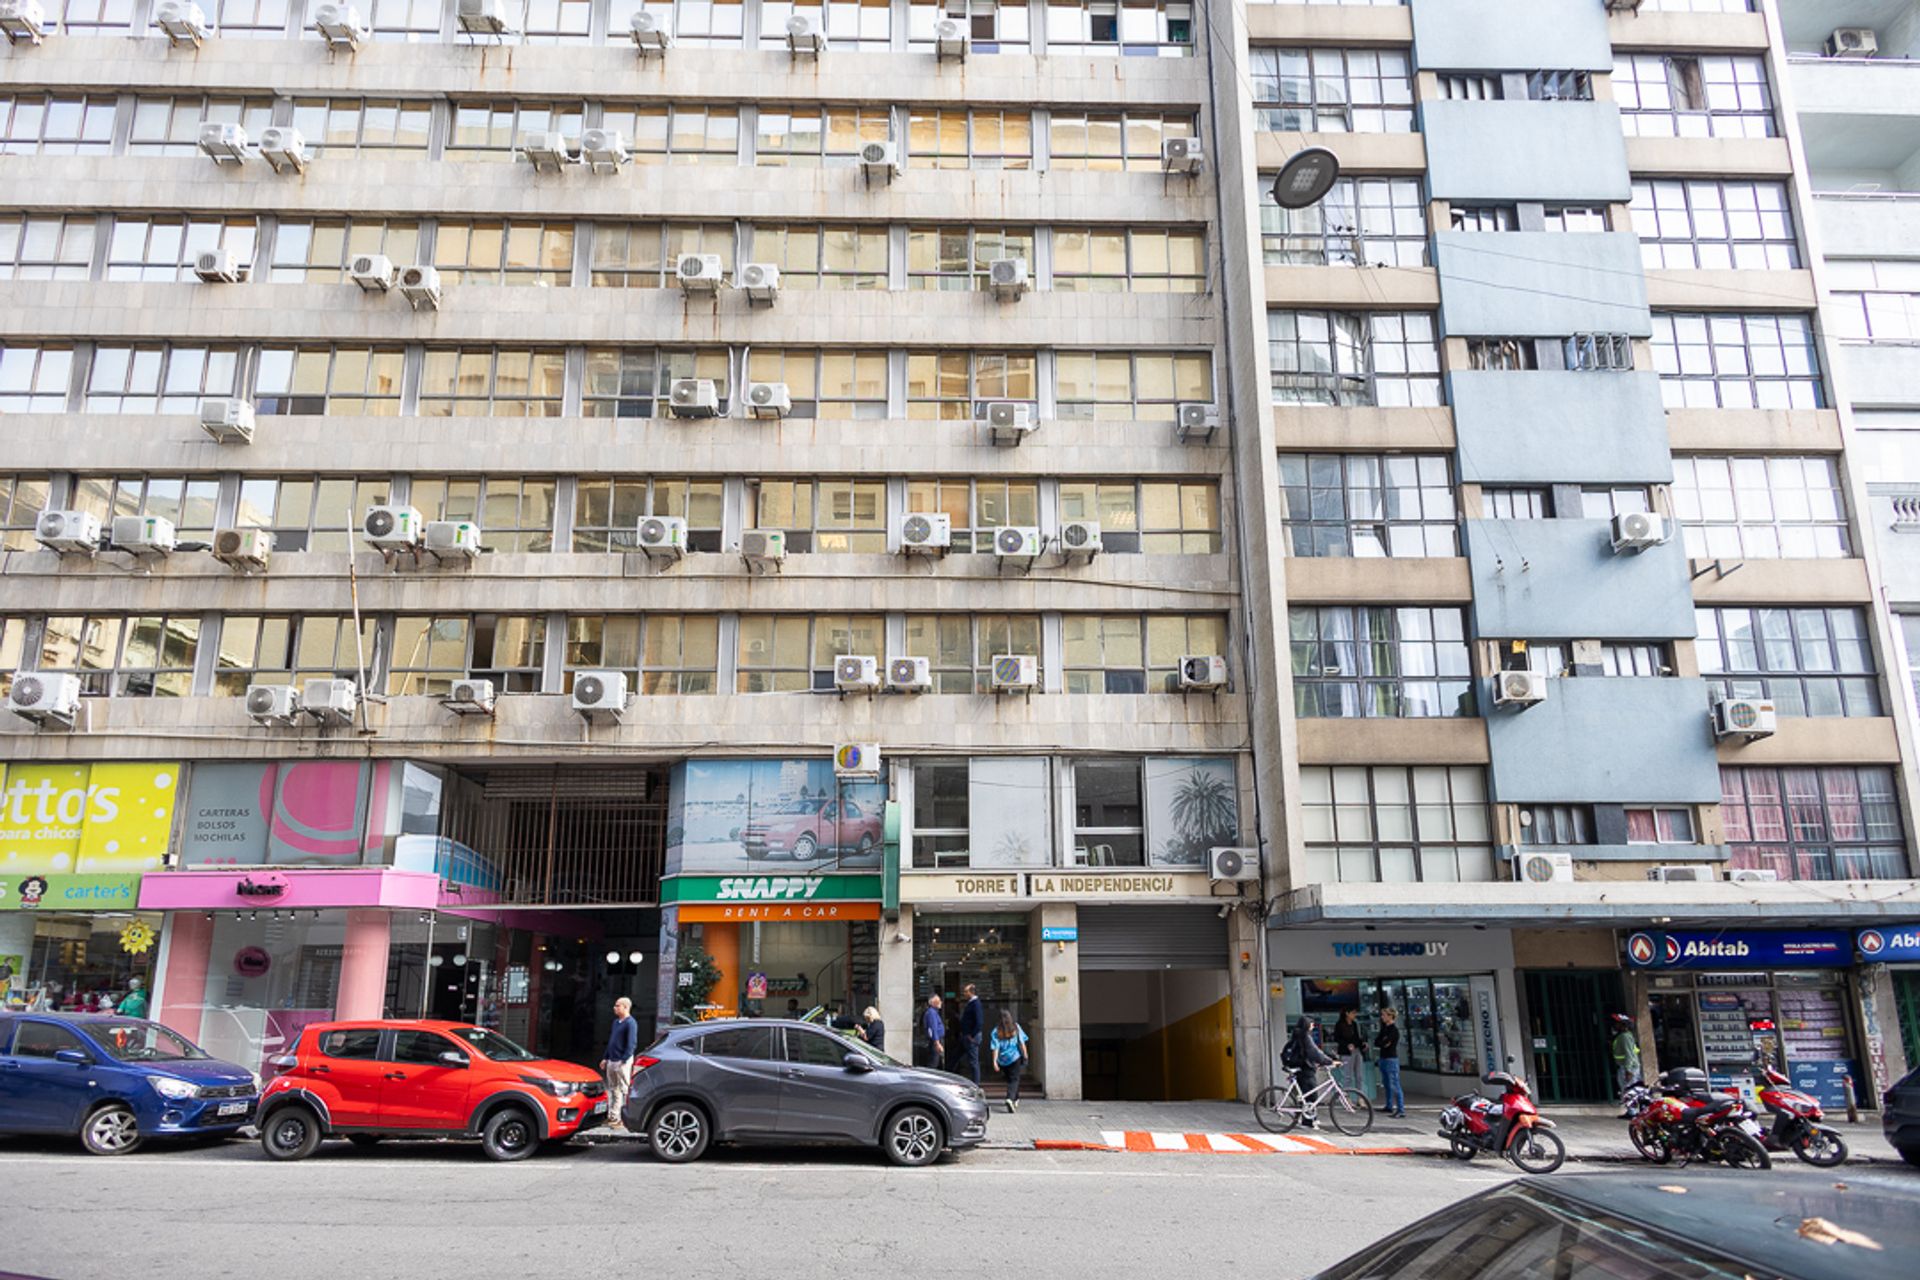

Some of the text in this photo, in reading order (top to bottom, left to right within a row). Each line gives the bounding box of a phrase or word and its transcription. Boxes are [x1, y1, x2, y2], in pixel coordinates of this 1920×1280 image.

[199, 808, 250, 817] CARTERAS
[197, 820, 236, 829] BOLSOS
[34, 826, 83, 840] chicos
[193, 832, 246, 842] MOCHILAS
[64, 883, 130, 899] carter's
[716, 877, 824, 899] SNAPPY
[955, 879, 1005, 893] TORRE
[1035, 878, 1055, 892] LA
[1061, 876, 1173, 892] INDEPENDENCIA
[724, 906, 838, 917] RENT A CAR
[1683, 939, 1750, 956] Abitab
